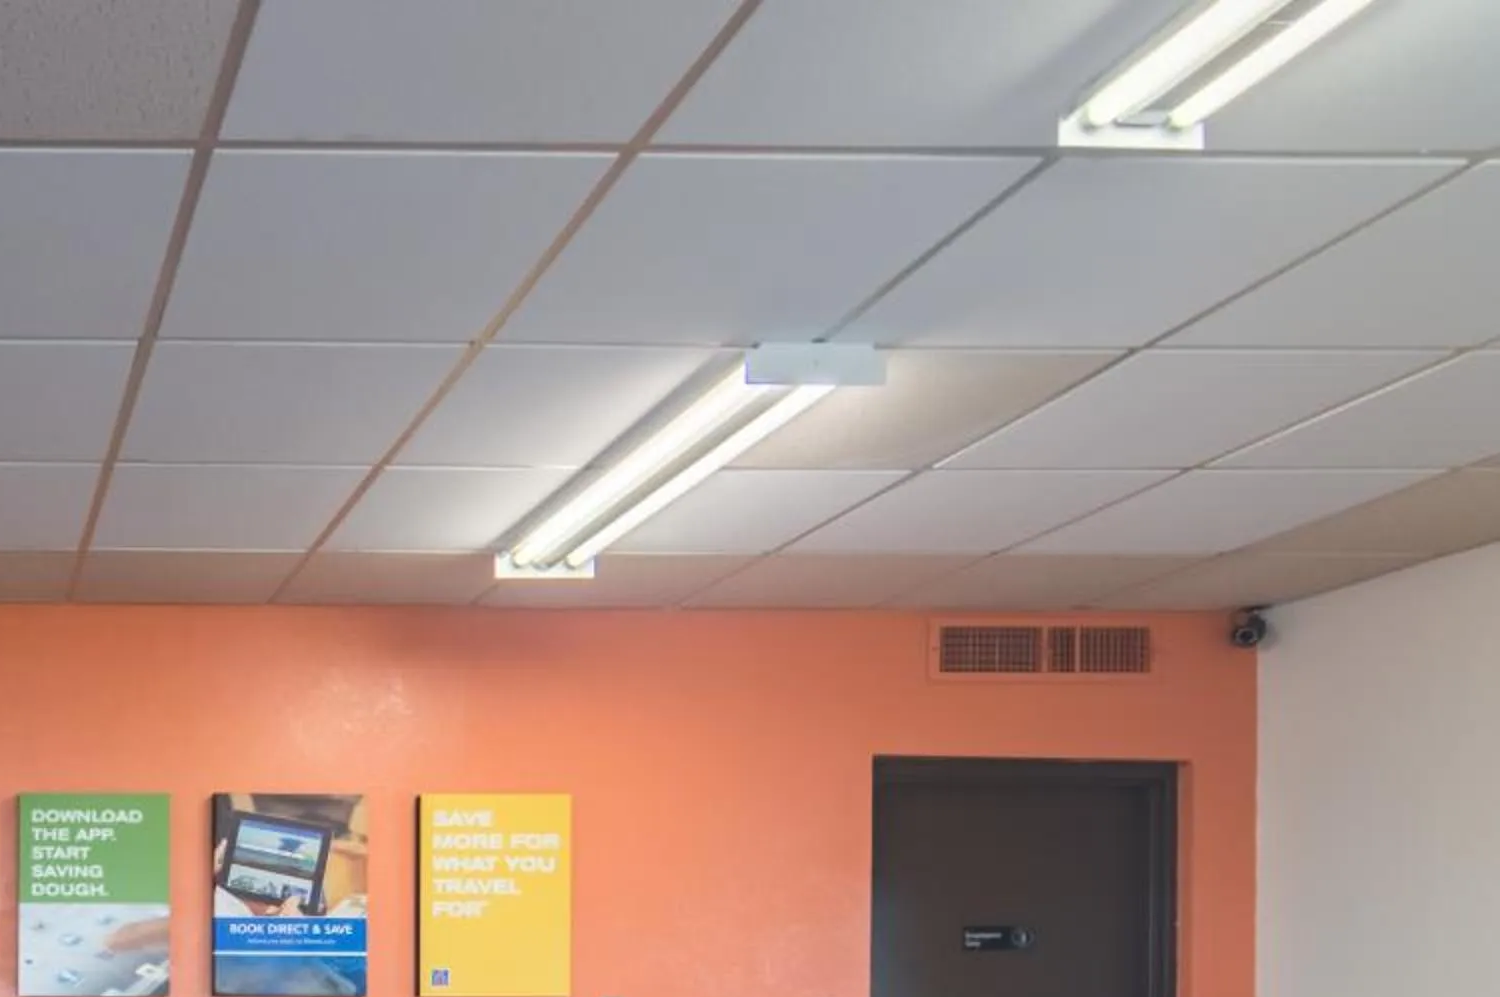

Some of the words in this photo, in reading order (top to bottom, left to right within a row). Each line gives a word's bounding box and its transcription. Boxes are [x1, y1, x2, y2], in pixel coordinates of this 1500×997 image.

[31, 809, 144, 823] DOWNLOAD
[432, 809, 492, 827] SAVE
[31, 828, 69, 841] THE
[75, 828, 117, 841] APP.
[432, 832, 503, 850] MORE
[510, 832, 560, 850] FOR
[31, 846, 91, 860] START
[432, 855, 498, 872] WHAT
[503, 854, 556, 873] YOU
[31, 865, 104, 879] SAVING
[31, 883, 108, 897] DOUGH.
[432, 878, 521, 896] TRAVEL
[229, 923, 265, 935] BOOK
[267, 923, 309, 935] DIRECT
[324, 923, 353, 935] SAVE
